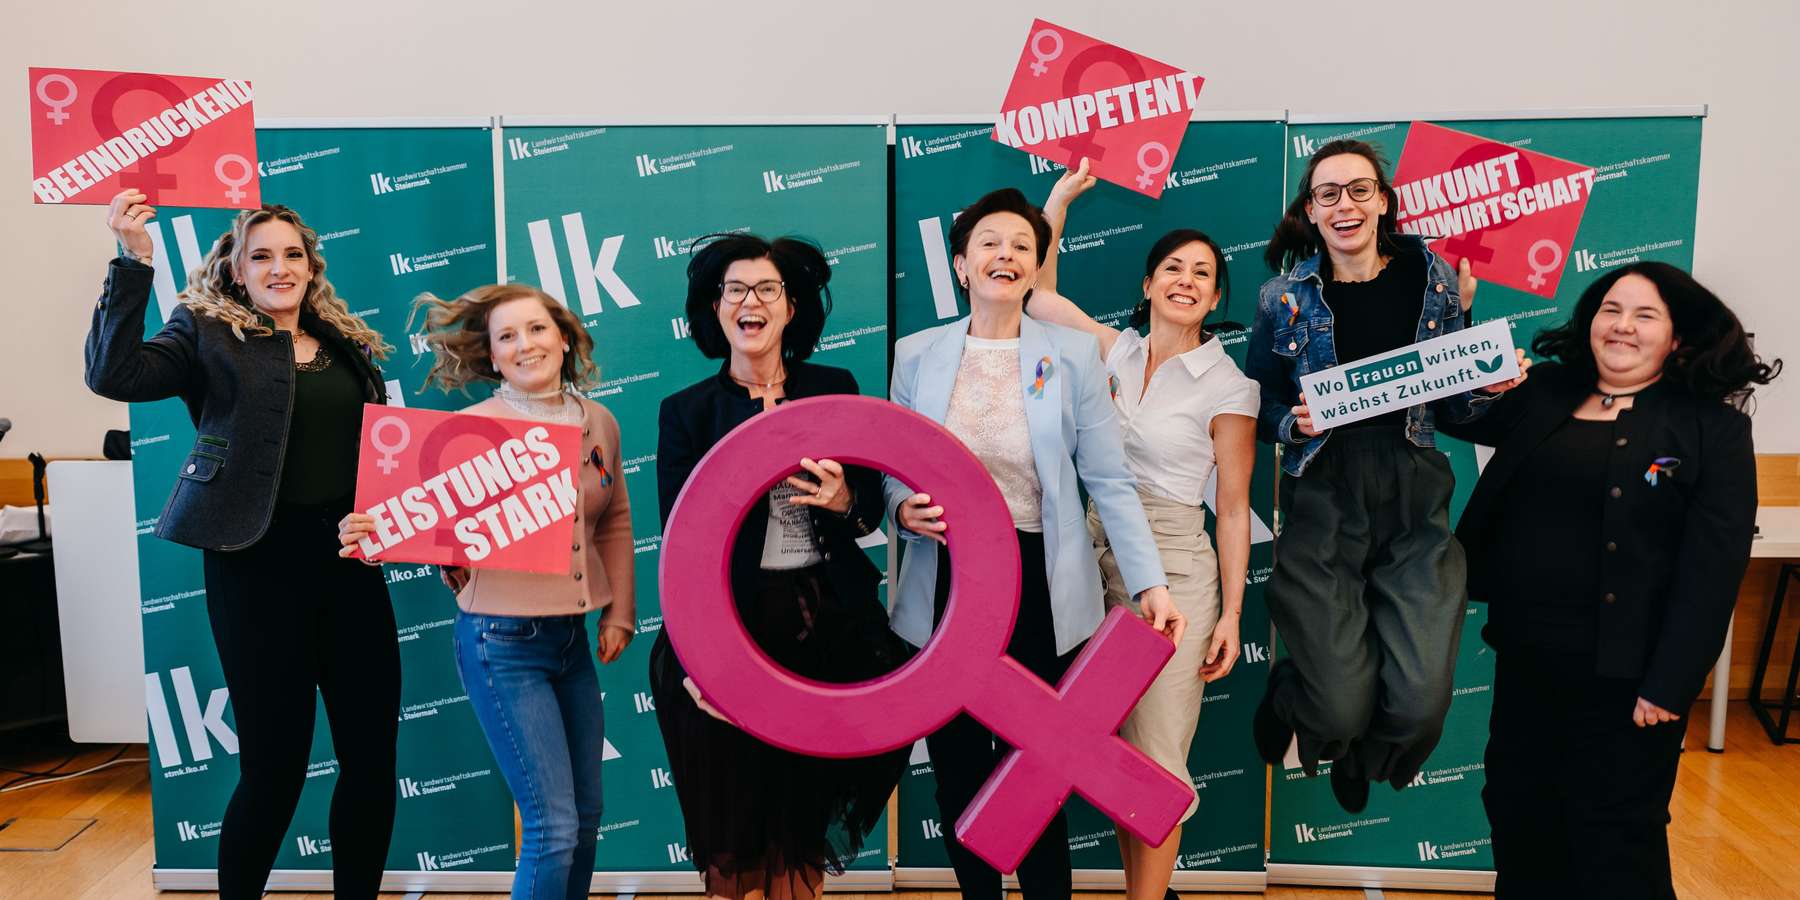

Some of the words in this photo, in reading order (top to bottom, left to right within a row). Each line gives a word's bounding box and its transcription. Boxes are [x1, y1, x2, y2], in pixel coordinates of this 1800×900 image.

[995, 71, 1199, 148] KOMPETENT
[33, 79, 252, 203] BEEINDRUCKEND
[532, 128, 606, 147] Landwirtschaftskammer
[925, 127, 993, 147] Landwirtschaftskamm
[1293, 135, 1315, 158] lk
[266, 147, 340, 167] Landwirtschaftskammer
[508, 138, 531, 160] lk
[533, 143, 568, 156] Steiermark
[659, 144, 733, 165] Landwirtschaftskammer
[902, 136, 924, 159] lk
[925, 141, 962, 155] Steiermark
[268, 163, 303, 176] Steiermark
[393, 162, 467, 183] Landwirtschaftskammer
[636, 154, 659, 177] lk
[660, 160, 696, 173] Steiermark
[785, 160, 861, 181] Landwirtschaftskammer
[1180, 157, 1258, 178] Landwirtschaftskammer
[1595, 153, 1671, 173] ndwirtschaftskammer
[370, 172, 393, 195] lk
[394, 178, 431, 191] Steiermark
[763, 170, 785, 193] lk
[787, 176, 823, 189] Steiermark
[1181, 172, 1218, 187] Steiermark
[1402, 168, 1595, 240] NDWIRTSCHAFT
[1067, 223, 1143, 243] Landwirtschaftskammer
[412, 243, 487, 263] Landwirtschaftskammer
[654, 237, 676, 259] lk
[824, 242, 877, 257] rtschaftskammer
[1069, 238, 1105, 252] Steiermark
[1600, 239, 1683, 260] Landwirtschaftskammer
[390, 253, 413, 275] lk
[414, 258, 449, 272] Steiermark
[528, 212, 641, 316] lk
[1575, 249, 1598, 272] lk
[1600, 255, 1640, 268] Steiermark
[820, 324, 887, 343] Landwirtschaftskamm
[820, 338, 856, 351] Steiermark
[1314, 379, 1344, 397] Wo
[1350, 359, 1418, 387] Frauen
[1425, 339, 1499, 366] wirken,
[587, 386, 623, 399] Steiermark
[1321, 391, 1390, 420] wächst
[1396, 368, 1480, 400] Zukunft.
[454, 467, 577, 561] STARK
[386, 565, 432, 584] .lko.at
[398, 619, 455, 634] wirtschaftskammer
[1244, 642, 1265, 663] lk
[634, 692, 656, 713] lk
[145, 666, 240, 768] lk
[420, 769, 491, 788] Landwirtschaftskammer
[651, 768, 673, 789] lk
[1193, 768, 1244, 783] rtschaftskammer
[1427, 763, 1484, 778] Landwirtschaftska
[1428, 773, 1464, 785] Steiermark
[399, 778, 421, 799] lk
[422, 783, 456, 795] Steiermark
[177, 821, 199, 842] lk
[922, 819, 943, 839] lk
[1295, 823, 1316, 843] lk
[1317, 817, 1390, 833] Landwirtschaftskammer
[1069, 839, 1100, 850] teiermark
[1318, 830, 1353, 841] Steiermark
[297, 836, 319, 857] lk
[438, 843, 509, 861] Landwirtschaftskammer
[667, 843, 688, 864] lk
[1185, 842, 1258, 860] Landwirtschaftskammer
[1417, 841, 1439, 862] lk
[1441, 848, 1477, 860] Steiermark
[417, 852, 439, 871] lk
[440, 857, 474, 869] Steiermark
[1187, 856, 1221, 868] Steiermark
